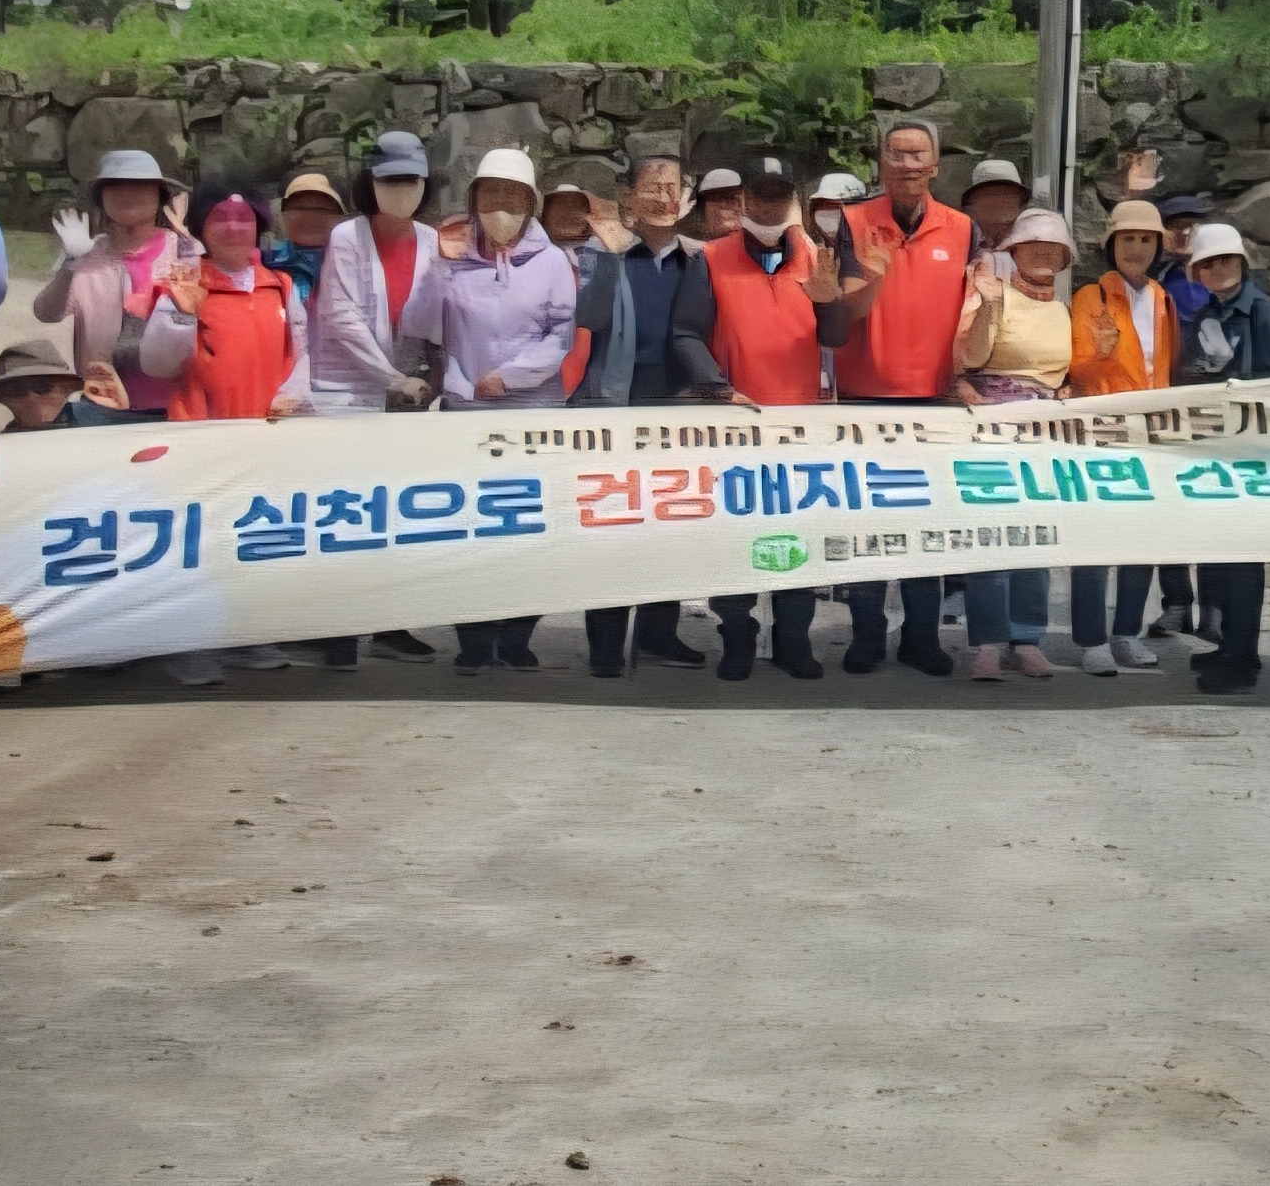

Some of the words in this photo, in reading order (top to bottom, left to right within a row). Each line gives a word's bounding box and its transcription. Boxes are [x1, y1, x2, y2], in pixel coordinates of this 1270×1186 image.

[42, 502, 201, 586] 걷기
[233, 478, 546, 562] 실천으로
[953, 456, 1156, 504] 둔내면
